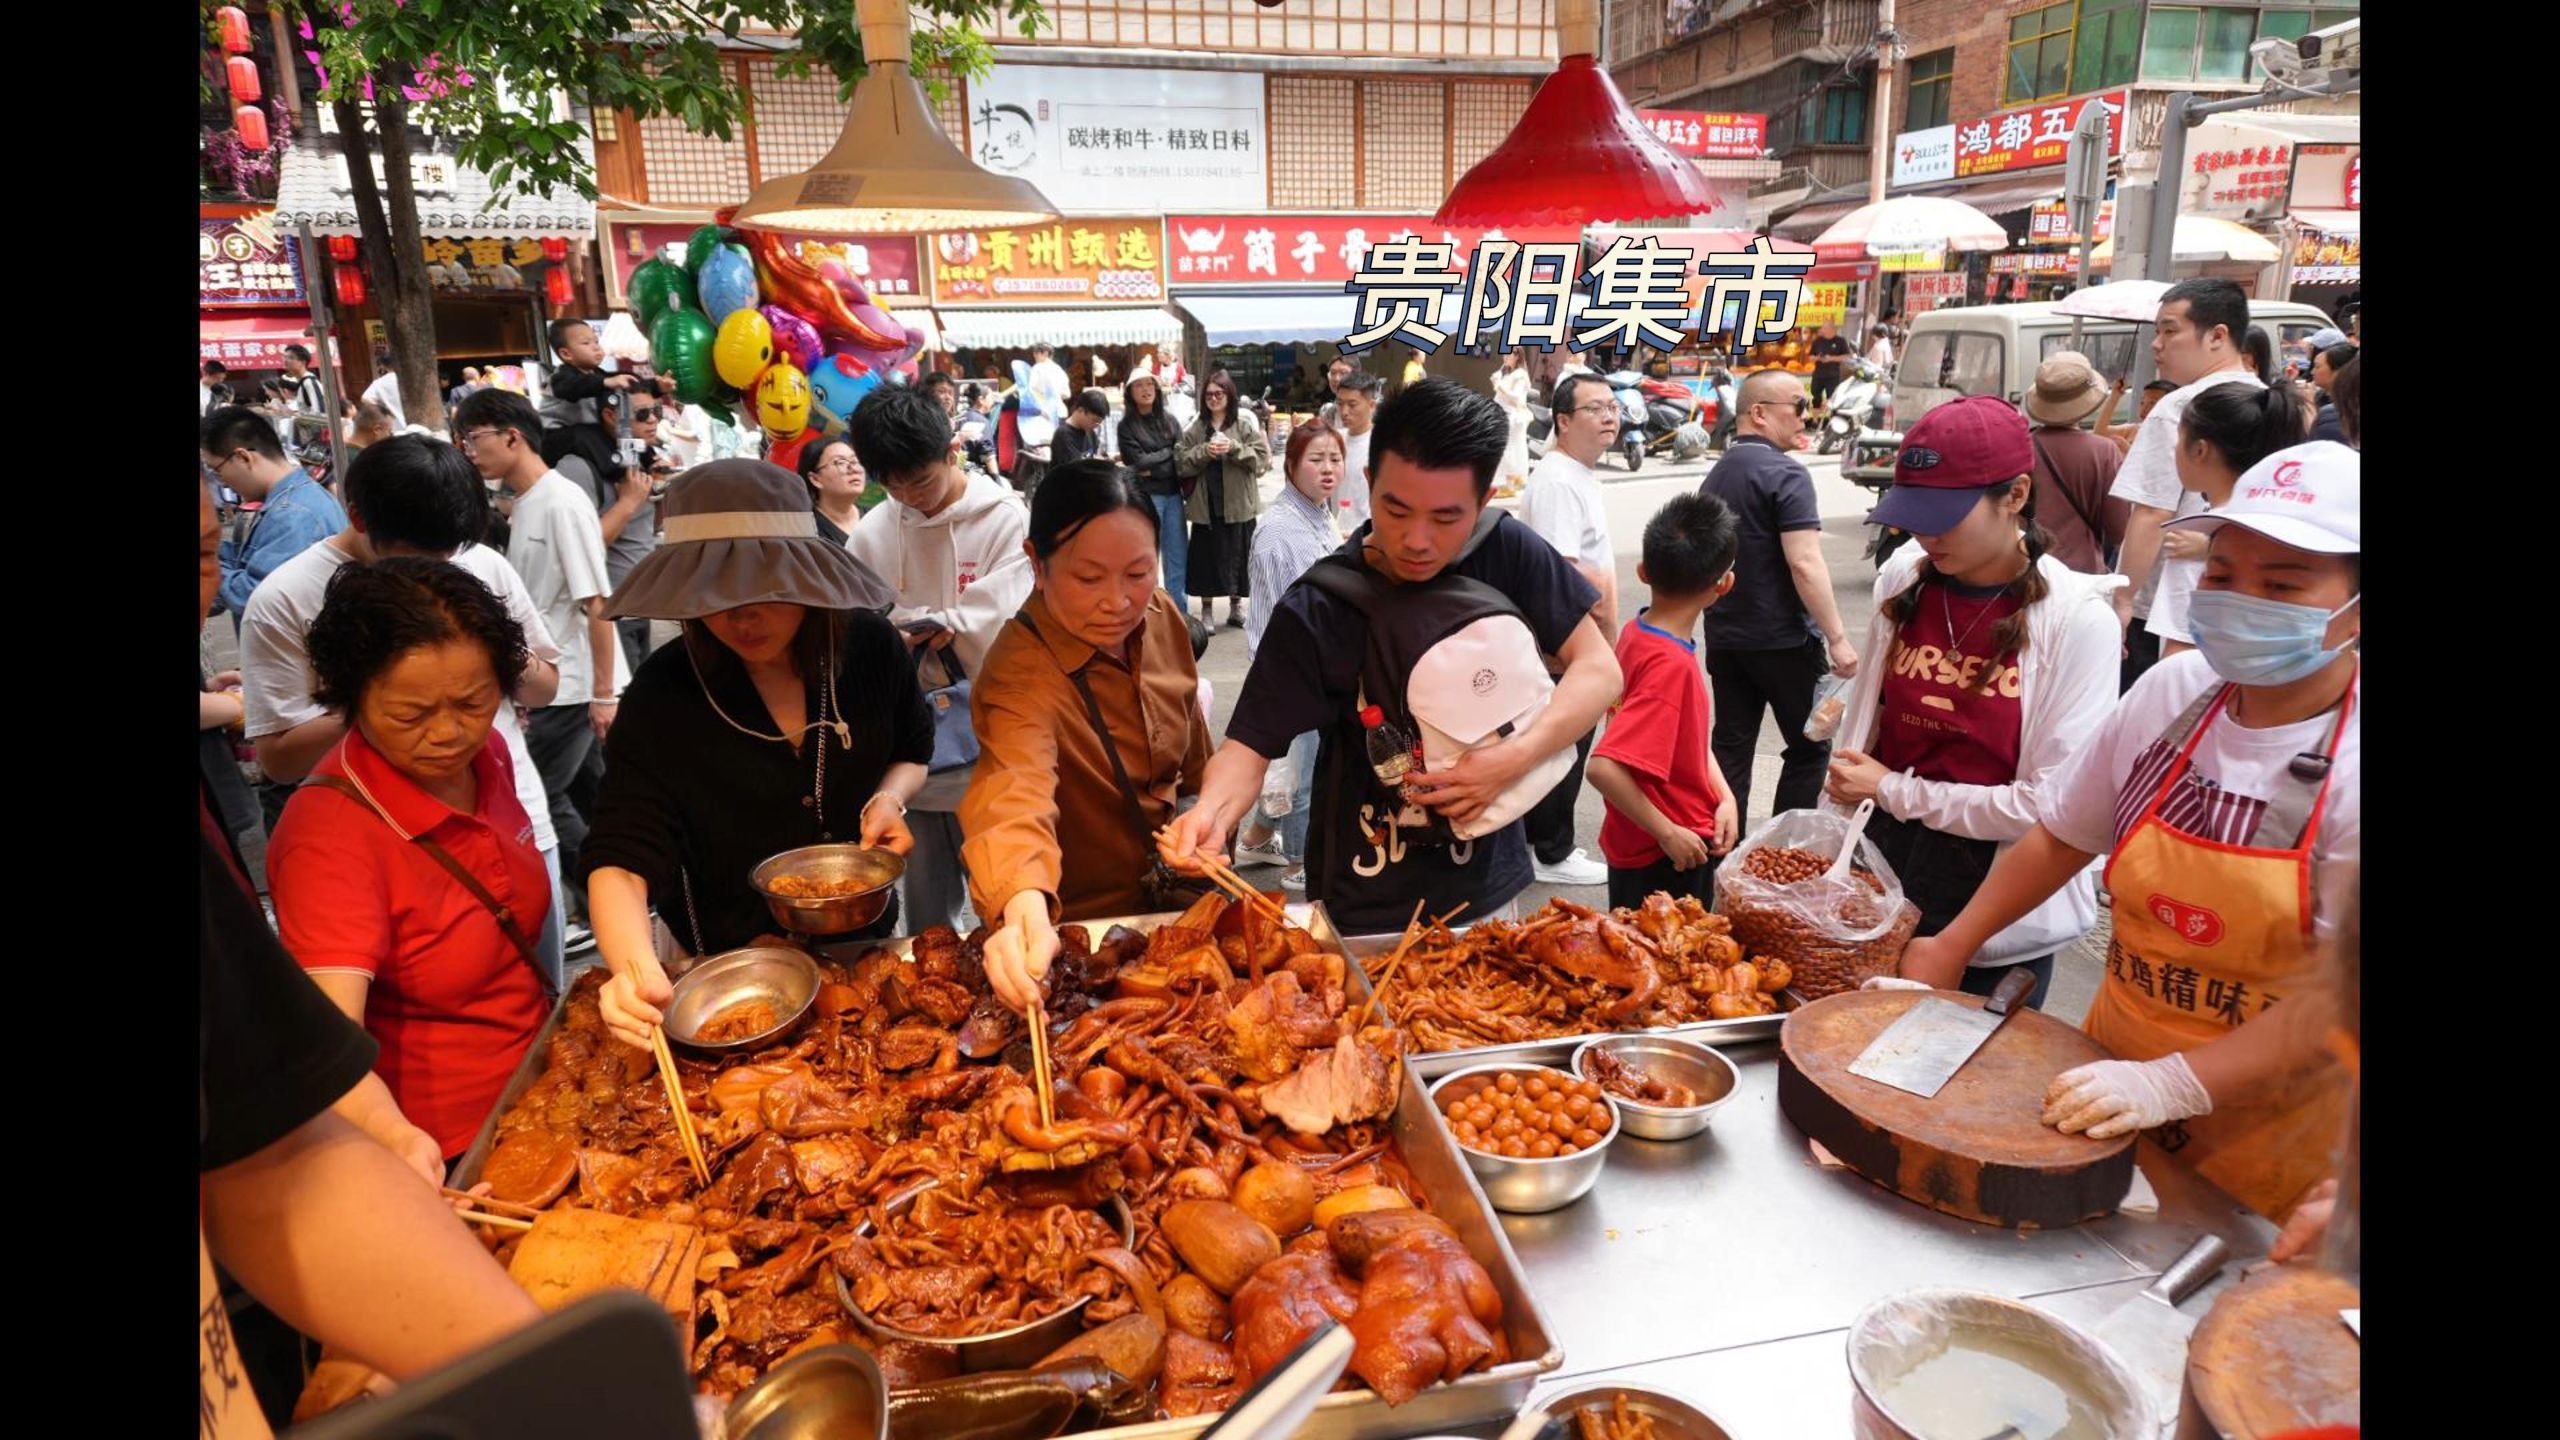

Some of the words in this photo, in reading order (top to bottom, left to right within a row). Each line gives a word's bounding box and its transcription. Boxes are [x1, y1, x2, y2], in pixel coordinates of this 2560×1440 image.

[1067, 127, 1251, 152] 碳烤和牛·精致日料
[1890, 640, 2021, 698] URSEZO
